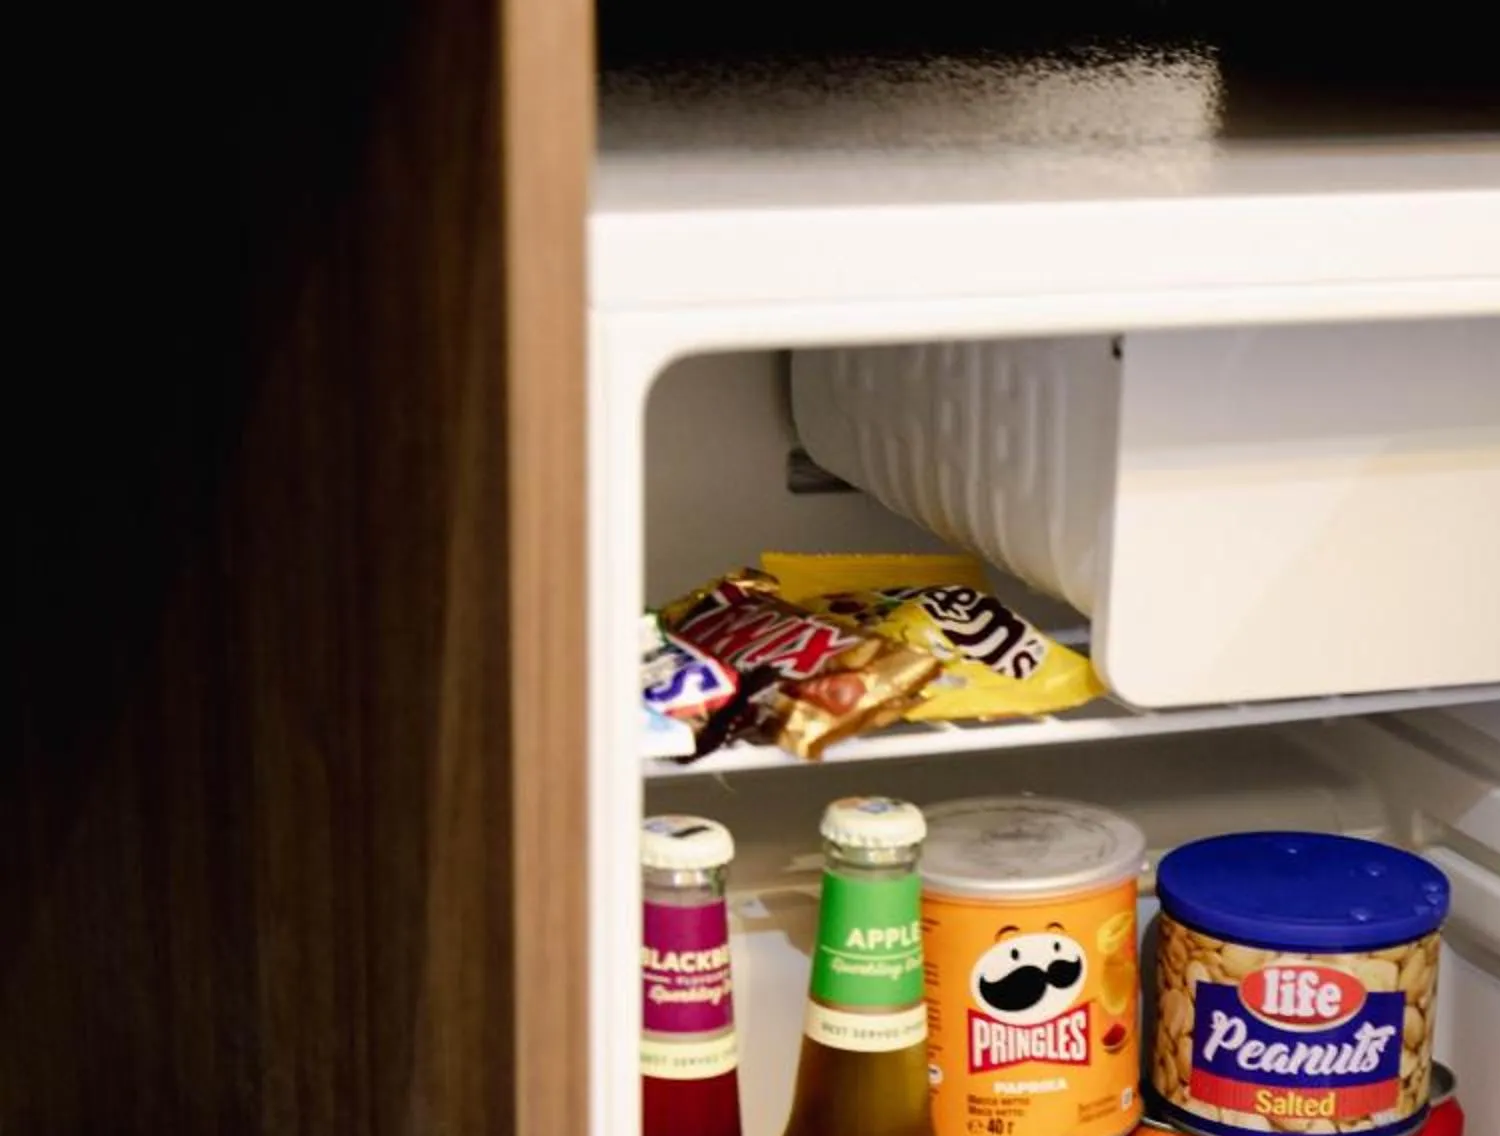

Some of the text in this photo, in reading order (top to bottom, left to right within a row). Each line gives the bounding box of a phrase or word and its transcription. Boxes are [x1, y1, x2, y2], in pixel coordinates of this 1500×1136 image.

[1260, 967, 1343, 1019] life
[973, 1010, 1087, 1067] PRINGLES
[1202, 1009, 1396, 1076] Peanuts
[1255, 1090, 1337, 1117] Salted
